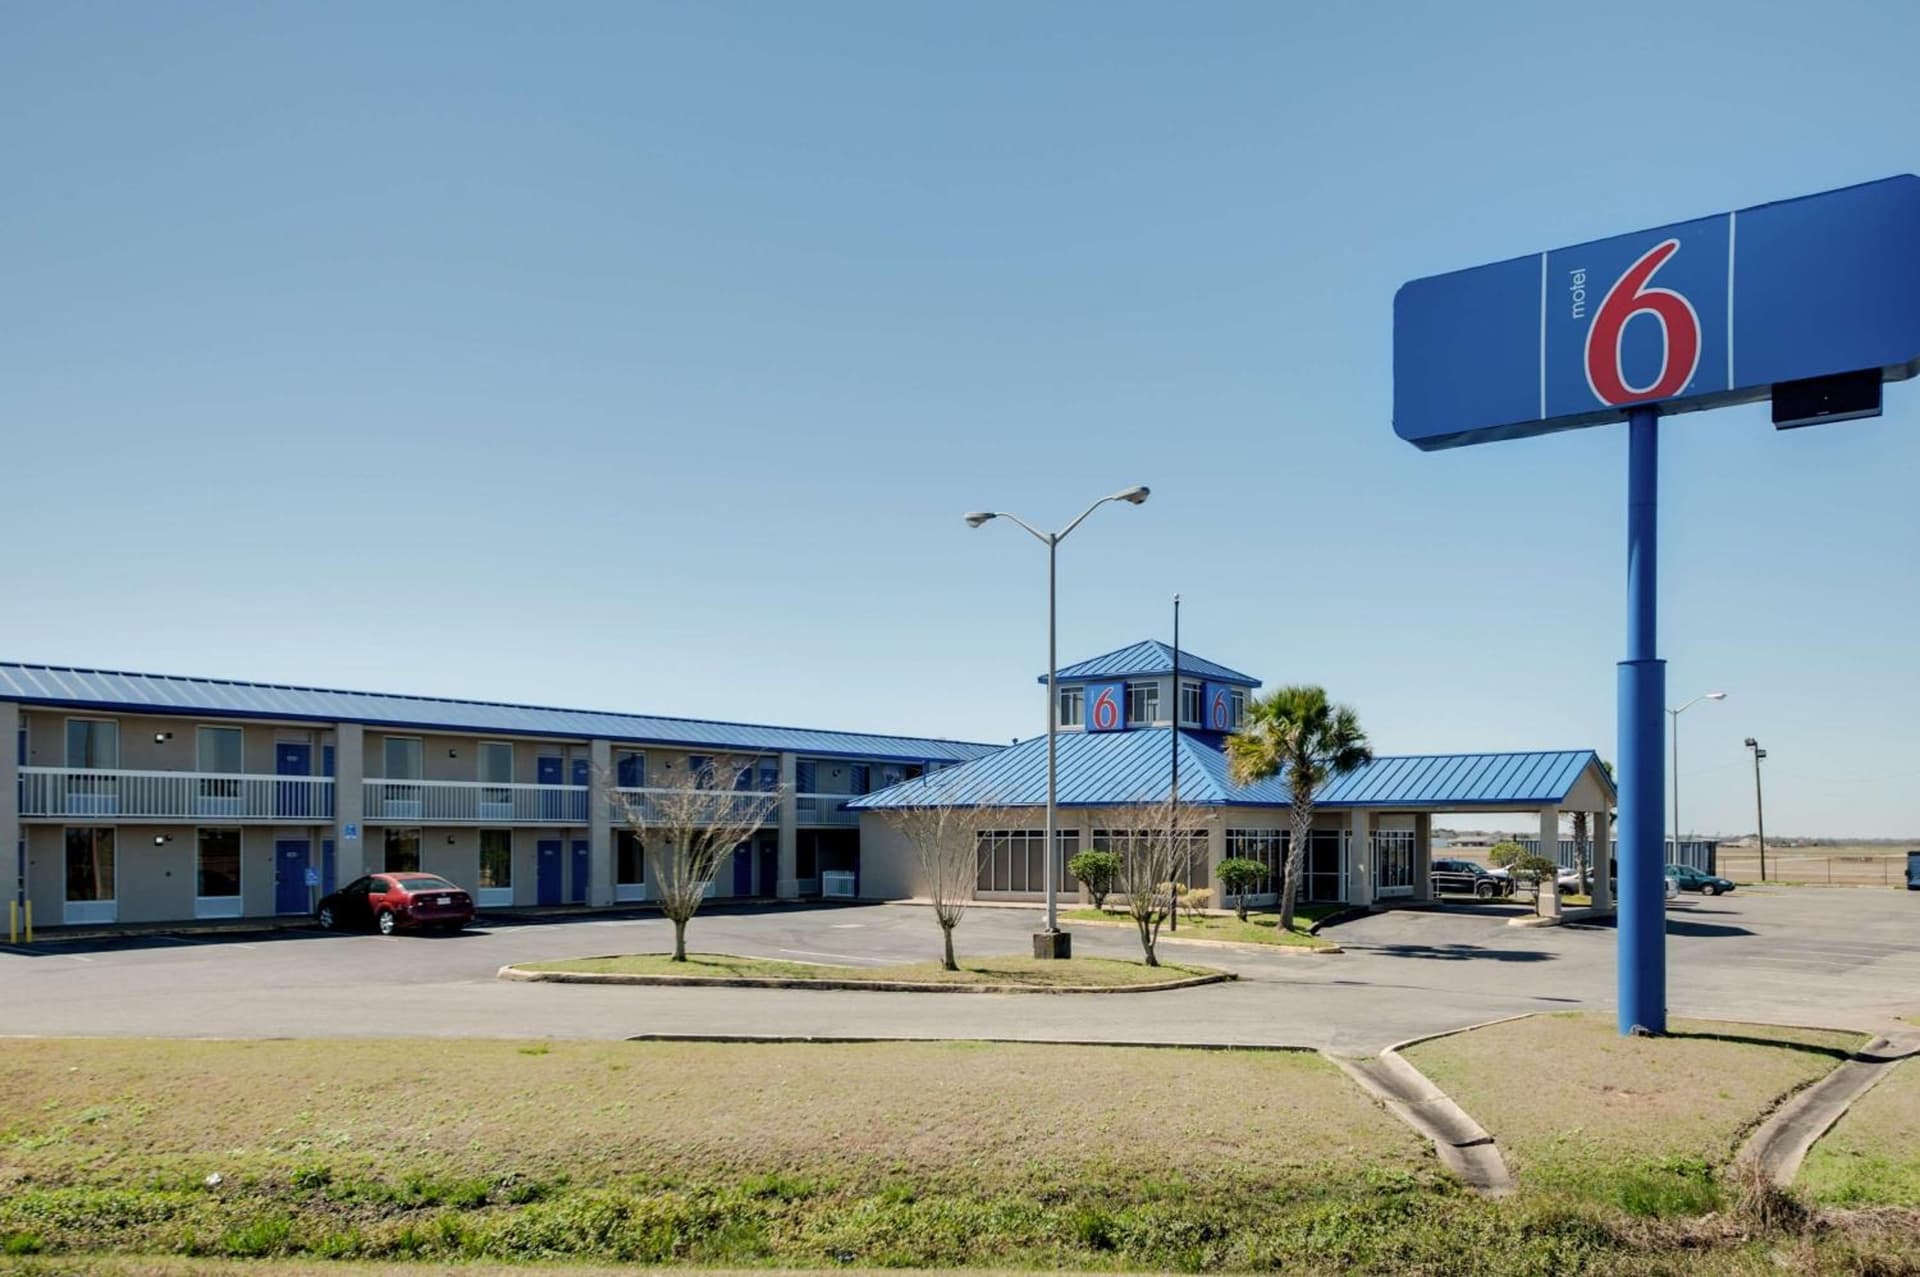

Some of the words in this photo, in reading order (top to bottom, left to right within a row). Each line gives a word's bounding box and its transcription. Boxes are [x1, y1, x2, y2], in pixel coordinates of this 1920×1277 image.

[1569, 268, 1587, 320] motel
[1584, 238, 1702, 406] 6
[1093, 686, 1117, 729] 6
[1213, 689, 1228, 730] 6
